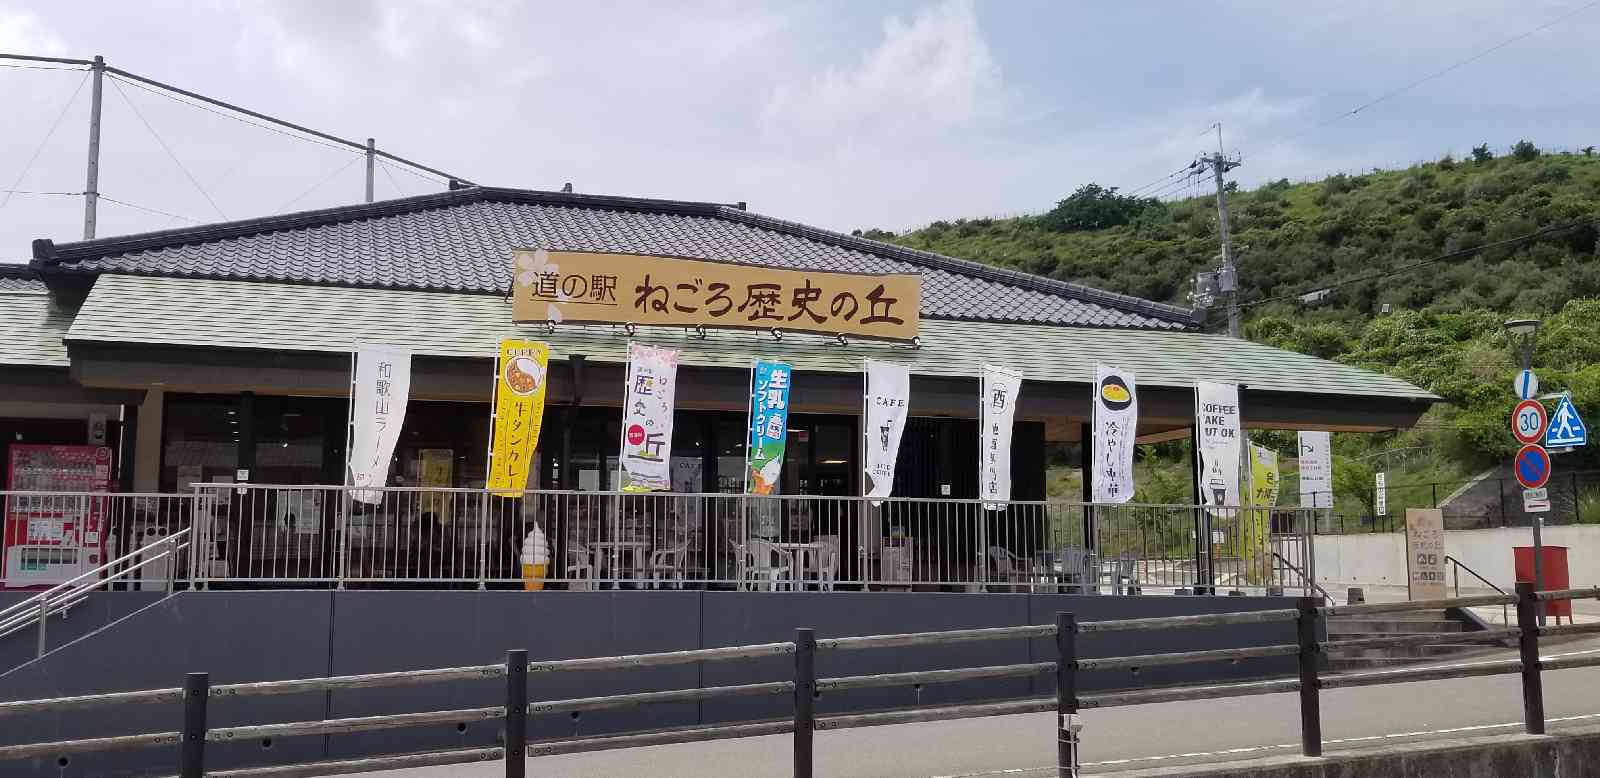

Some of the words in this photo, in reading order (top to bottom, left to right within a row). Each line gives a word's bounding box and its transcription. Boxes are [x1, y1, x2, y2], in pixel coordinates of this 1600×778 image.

[531, 272, 618, 303] 道の駅
[634, 273, 904, 325] ねごろ歴史の丘
[876, 396, 905, 408] CAFE
[756, 379, 769, 461] ソフトクリーム
[1203, 414, 1225, 426] AKE
[1520, 412, 1538, 431] 30
[1203, 427, 1219, 438] UT
[1221, 428, 1236, 439] OK
